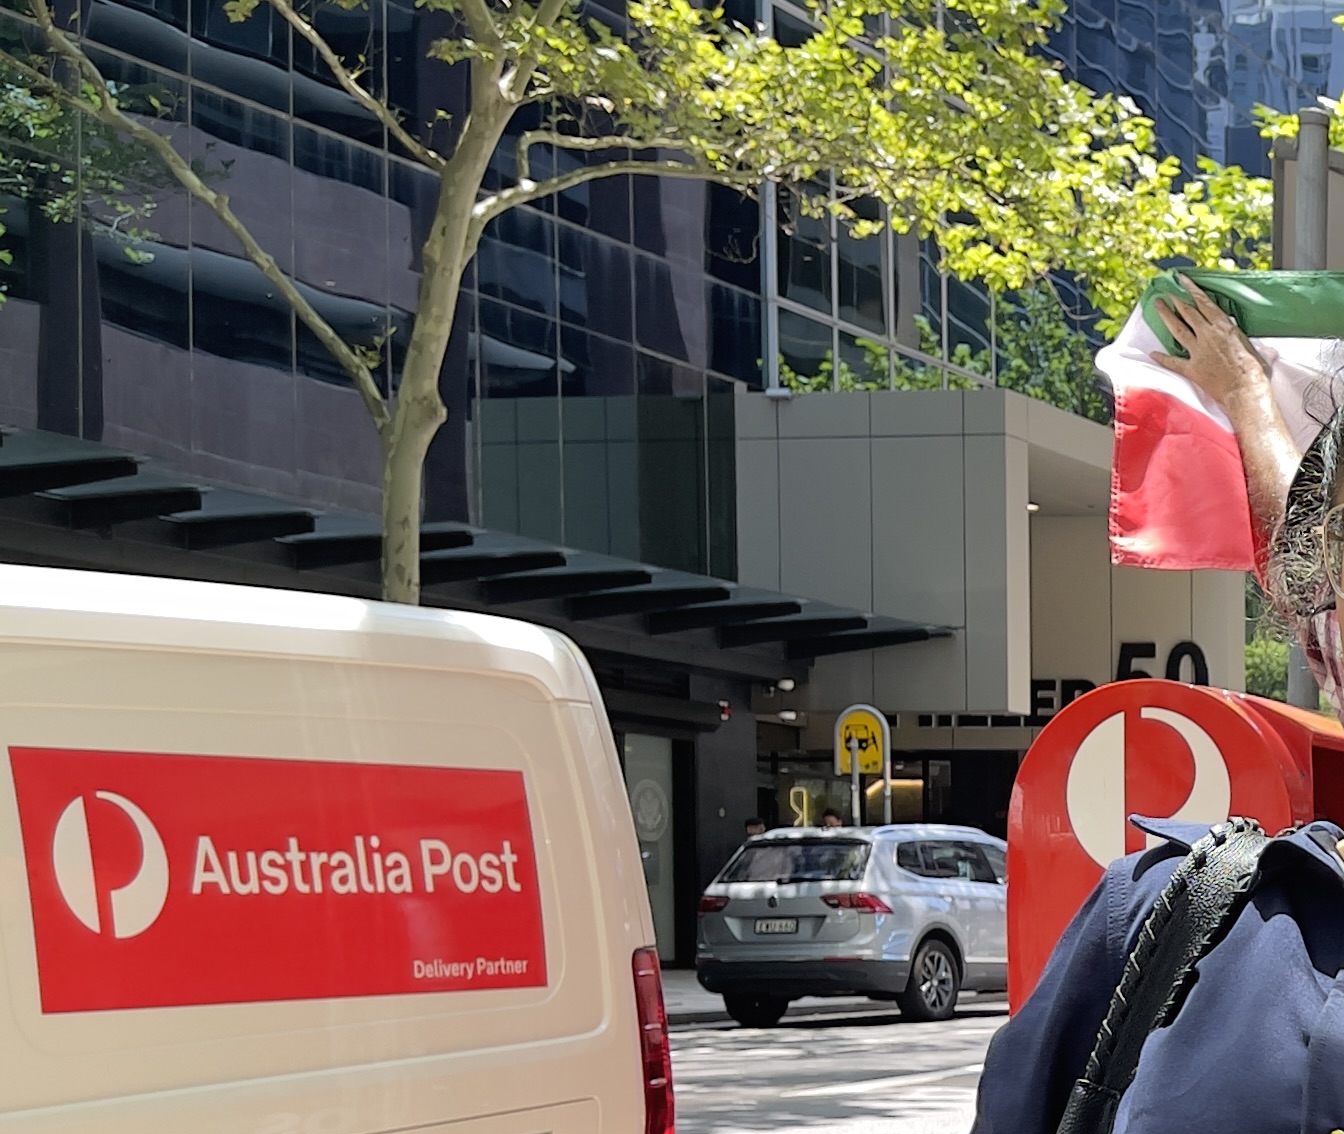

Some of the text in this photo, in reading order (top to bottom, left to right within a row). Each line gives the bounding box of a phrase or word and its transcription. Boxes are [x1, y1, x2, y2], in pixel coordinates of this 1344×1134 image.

[192, 835, 522, 895] Australia Post
[413, 957, 528, 980] Delivery Partner
